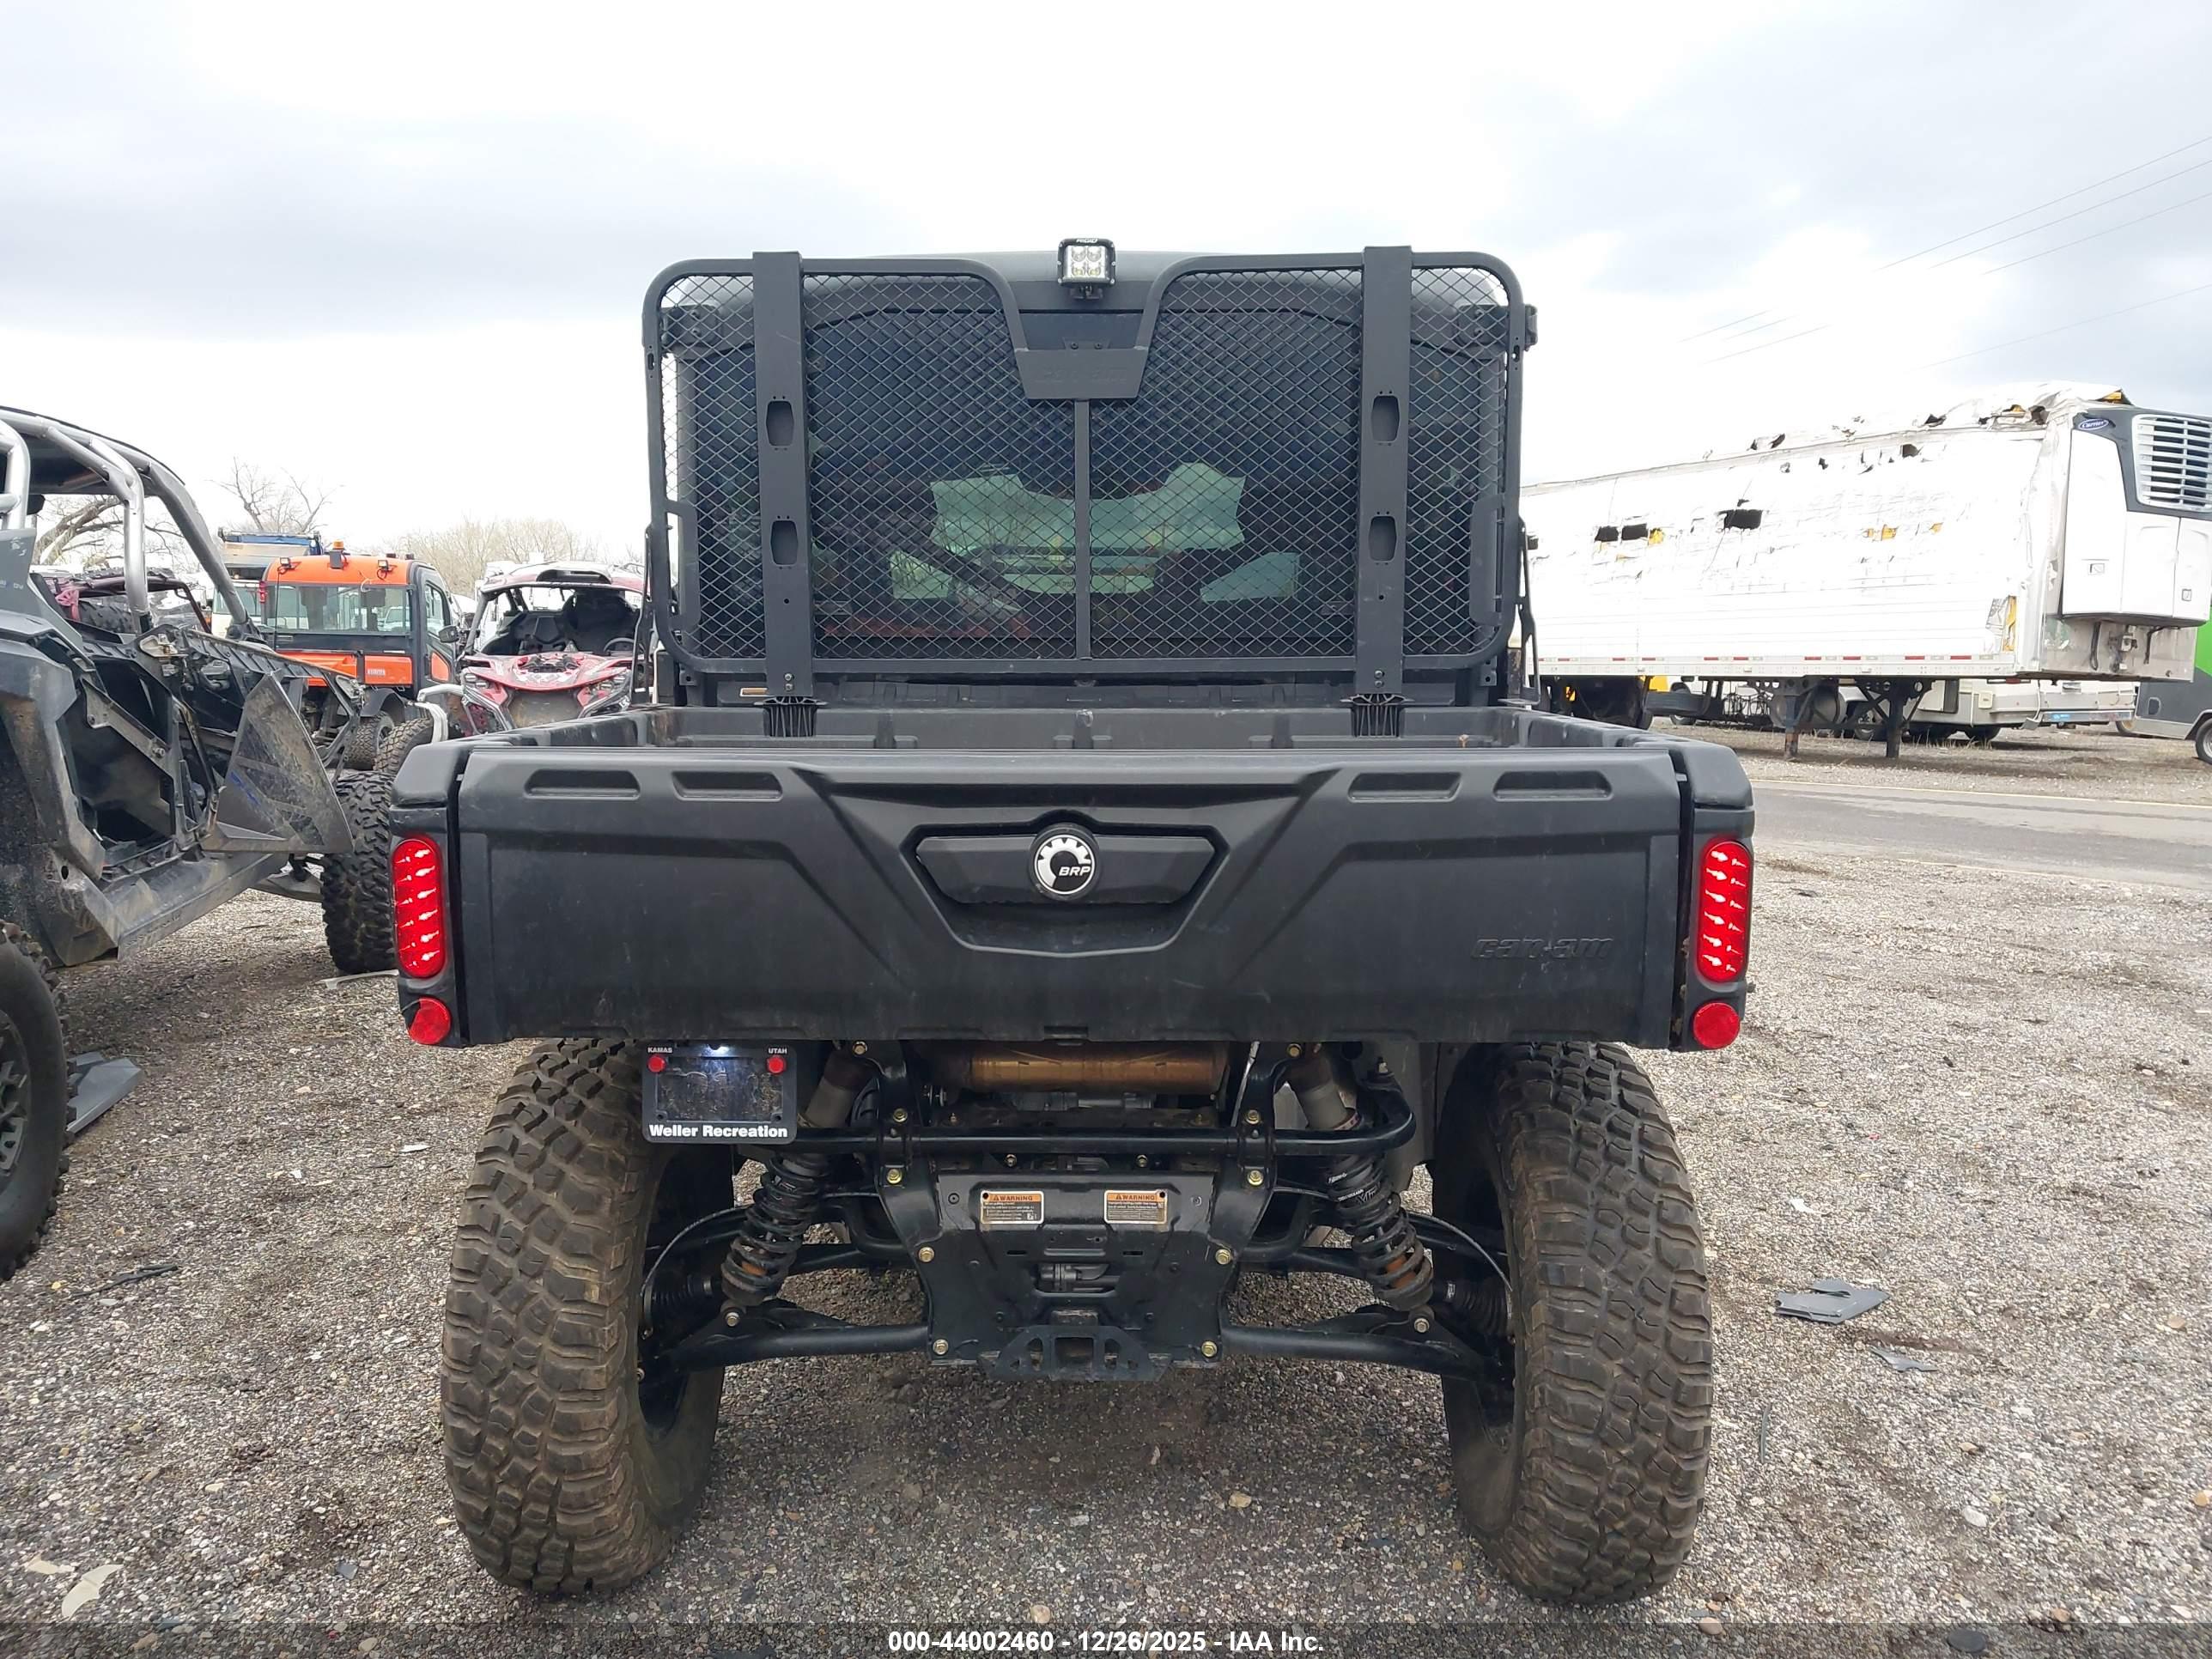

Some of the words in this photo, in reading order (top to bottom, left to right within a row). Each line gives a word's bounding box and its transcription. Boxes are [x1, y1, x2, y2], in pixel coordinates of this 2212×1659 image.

[1058, 866, 1091, 877] BRP
[648, 1124, 699, 1137] Weller
[702, 1124, 788, 1138] Recreation
